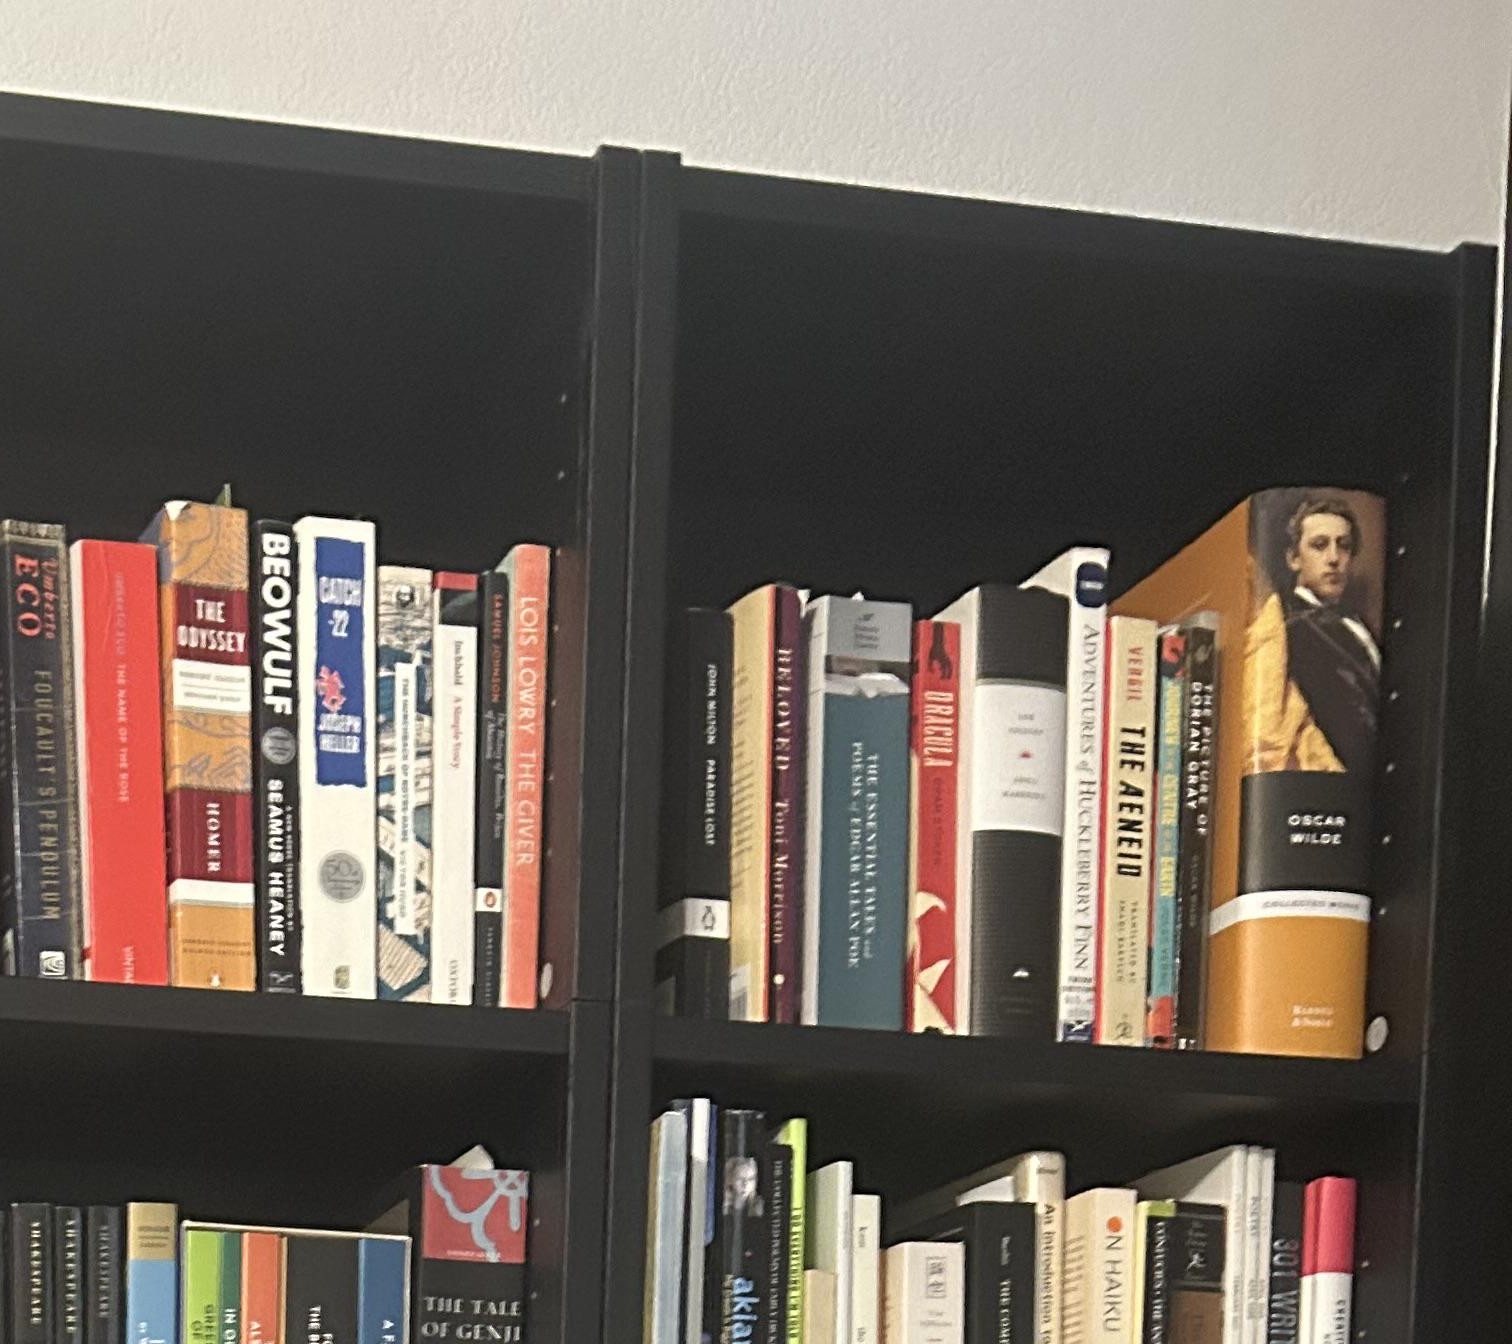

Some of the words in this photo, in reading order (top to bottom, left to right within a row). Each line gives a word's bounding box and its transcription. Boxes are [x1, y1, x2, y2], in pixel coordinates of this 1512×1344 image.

[16, 554, 39, 637] ECO
[263, 533, 292, 714] BEOWULF
[519, 597, 537, 646] LOIS
[517, 657, 536, 734] LOWRY
[775, 648, 791, 771] BELOVED
[923, 691, 955, 767] DRACULA
[1078, 624, 1102, 756] ADVENTURES
[35, 671, 54, 796] FOUCAULT'S
[519, 751, 536, 791] THE
[1076, 760, 1097, 772] of
[1120, 726, 1146, 772] THE
[268, 780, 283, 862] SEAMUS
[516, 800, 534, 865] GIVER
[773, 799, 788, 847] Toni
[1074, 780, 1097, 917] HUCKLEBERRY
[1117, 780, 1145, 877] AENEID
[40, 810, 59, 920] PENDULUM
[772, 854, 788, 943] Morrison
[268, 872, 285, 955] HEANEY
[1072, 924, 1093, 970] FINN
[1273, 1239, 1296, 1277] 301
[308, 1306, 319, 1329] THE
